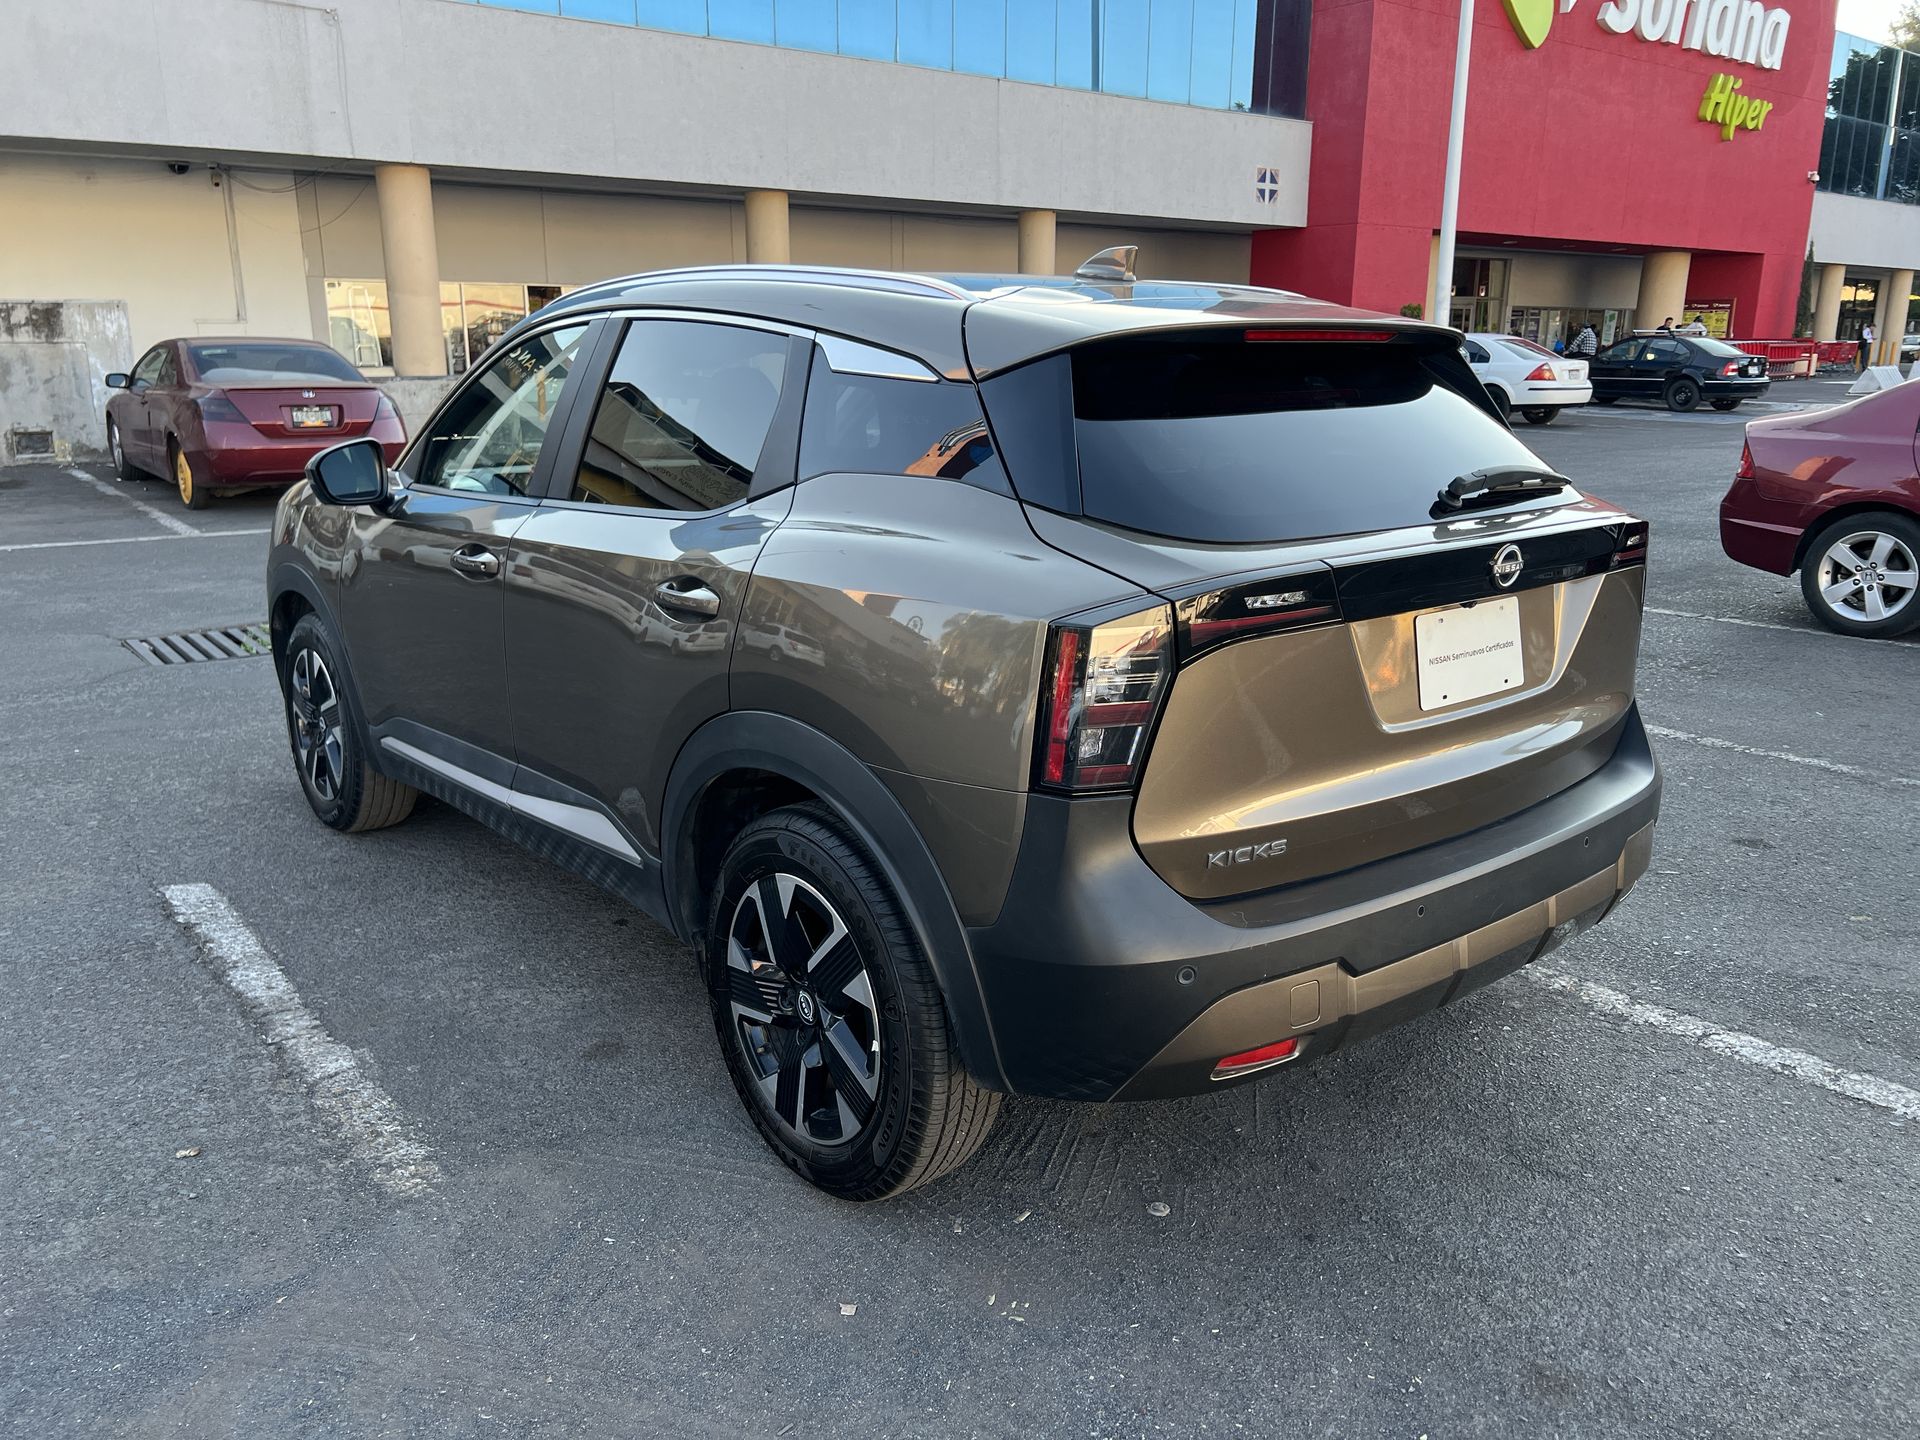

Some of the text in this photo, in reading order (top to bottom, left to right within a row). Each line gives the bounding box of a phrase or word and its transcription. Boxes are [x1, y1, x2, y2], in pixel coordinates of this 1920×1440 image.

[1698, 72, 1773, 141] Hiper
[1428, 640, 1514, 666] NISSAN Seminuevos Certificados
[1206, 839, 1288, 869] KICKS
[877, 1085, 900, 1153] SEASON
